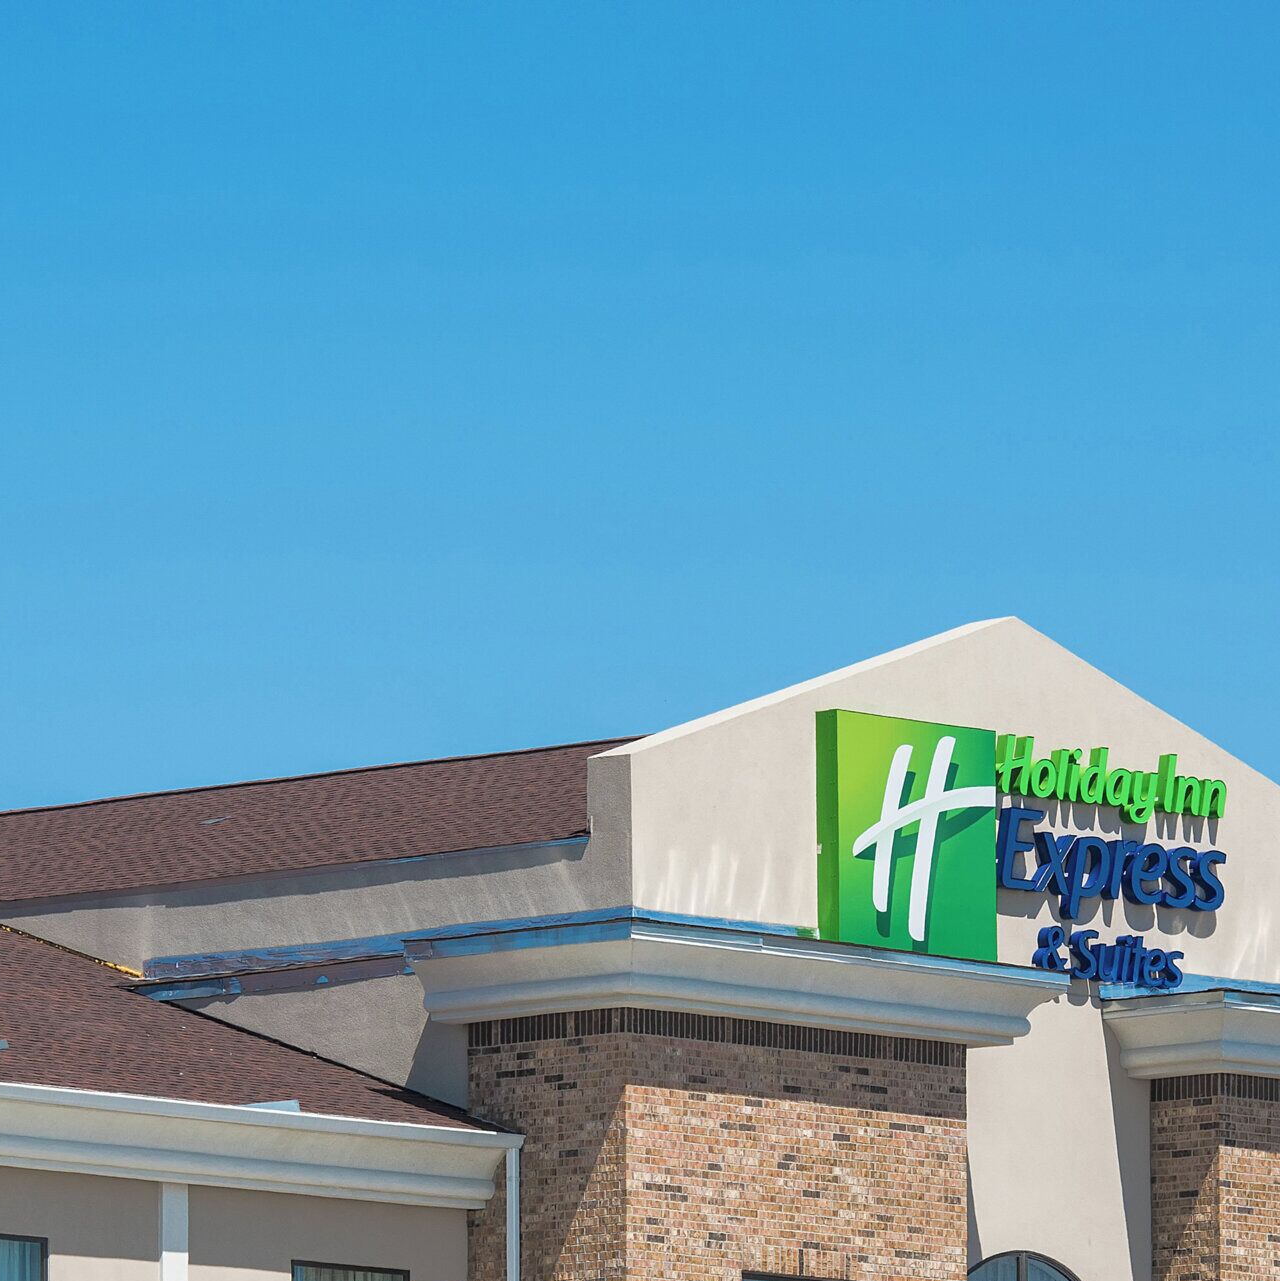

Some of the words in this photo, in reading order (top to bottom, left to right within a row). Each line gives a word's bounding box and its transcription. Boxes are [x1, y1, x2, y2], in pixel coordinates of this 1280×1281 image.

[996, 734, 1158, 824] Holiday
[1157, 753, 1227, 818] Inn
[996, 806, 1227, 920] Express
[1032, 925, 1068, 970] &
[1070, 929, 1184, 989] Suites
